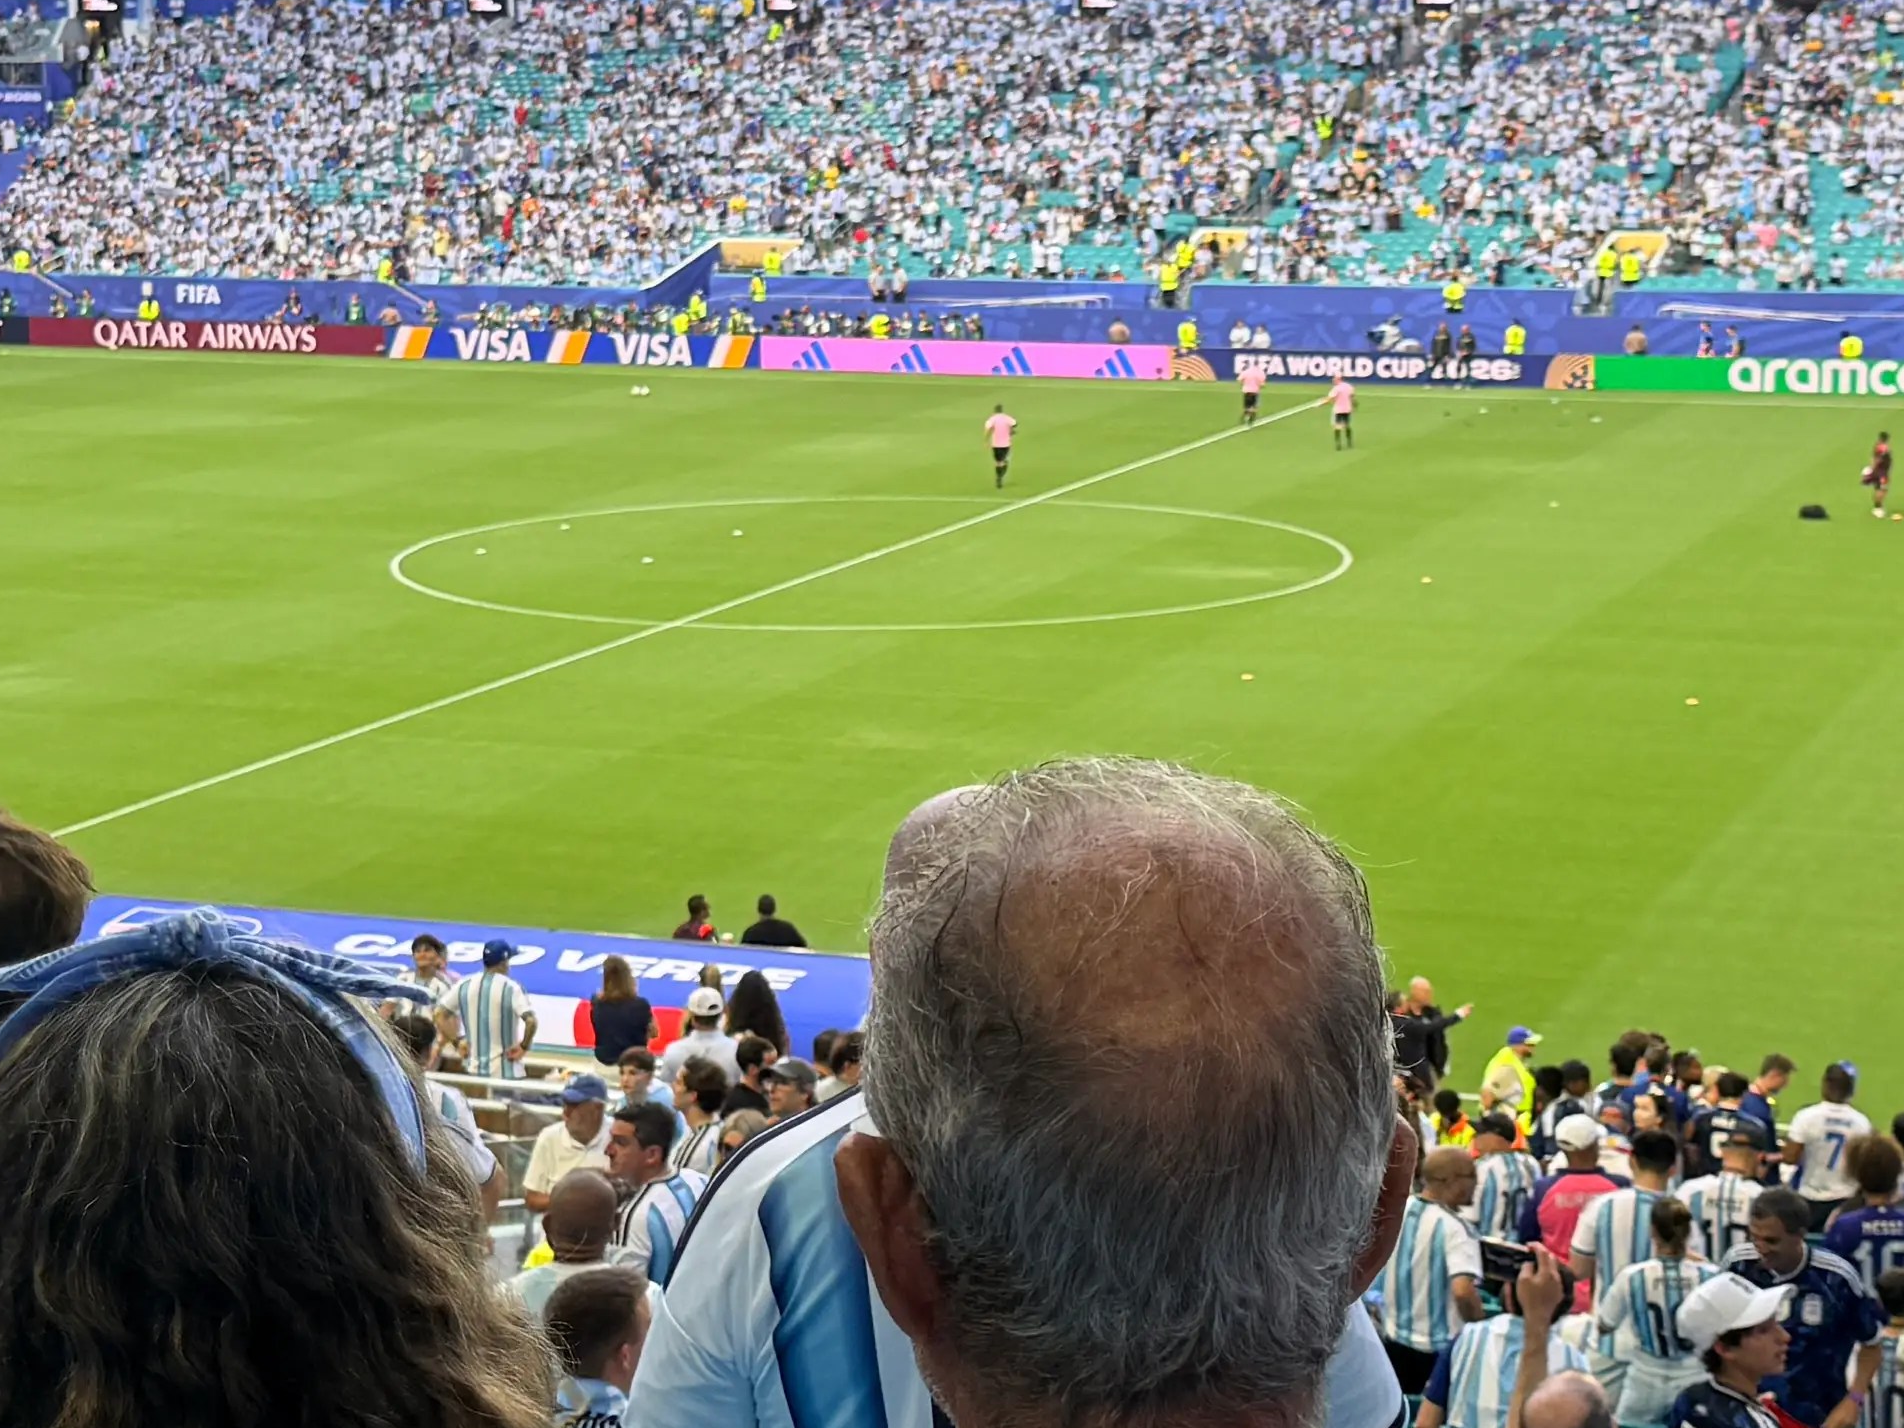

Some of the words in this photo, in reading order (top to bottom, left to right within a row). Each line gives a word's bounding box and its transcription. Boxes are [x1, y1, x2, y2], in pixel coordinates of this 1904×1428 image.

[176, 284, 221, 306] FIFA
[94, 319, 188, 351] QATAR
[198, 322, 317, 353] AIRWAYS
[456, 327, 532, 362] VISA
[614, 333, 693, 367] VISA
[1234, 354, 1287, 377] FIFA
[1290, 355, 1374, 379] WORLD
[1375, 355, 1424, 379] CUP
